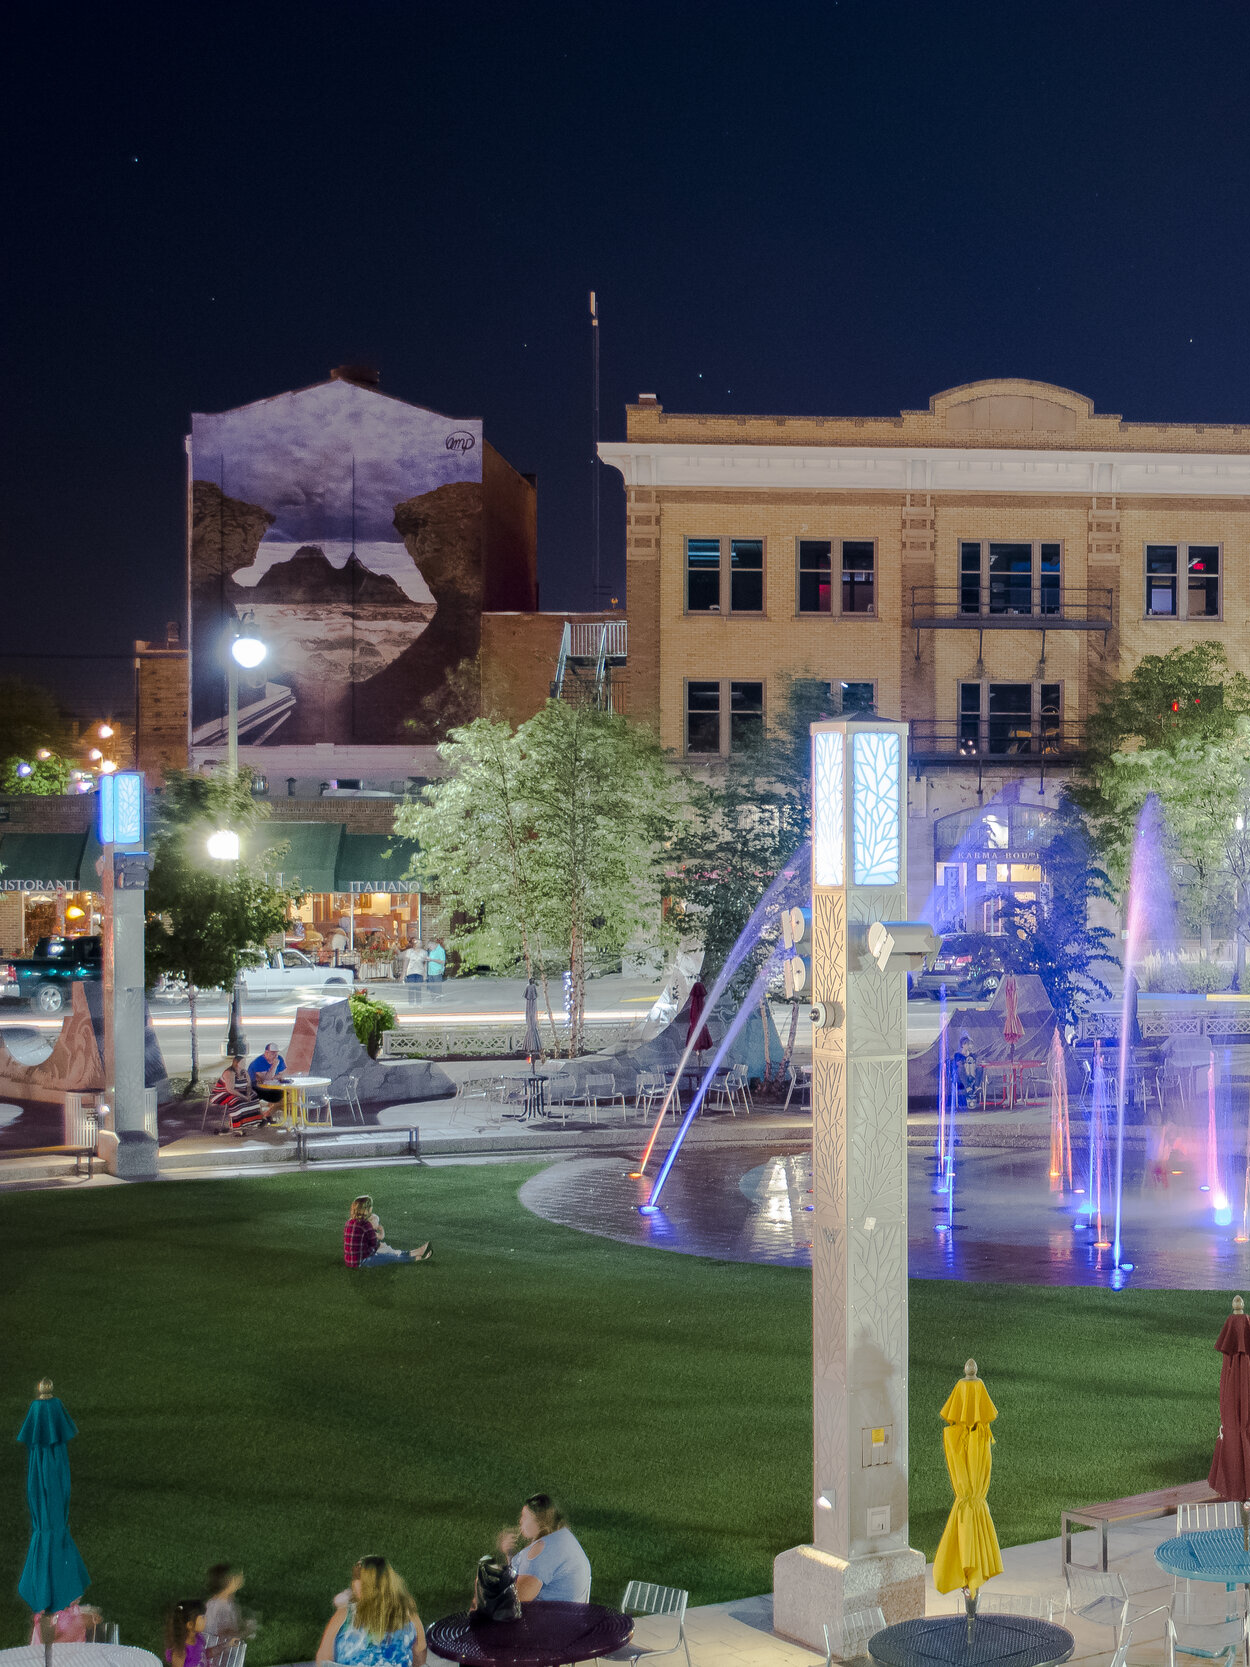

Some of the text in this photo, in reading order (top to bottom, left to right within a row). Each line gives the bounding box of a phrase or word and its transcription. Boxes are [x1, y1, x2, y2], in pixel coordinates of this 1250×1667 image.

[958, 851, 998, 860] KARMA
[0, 879, 80, 891] ISTORANT
[349, 880, 420, 893] ITALIANO
